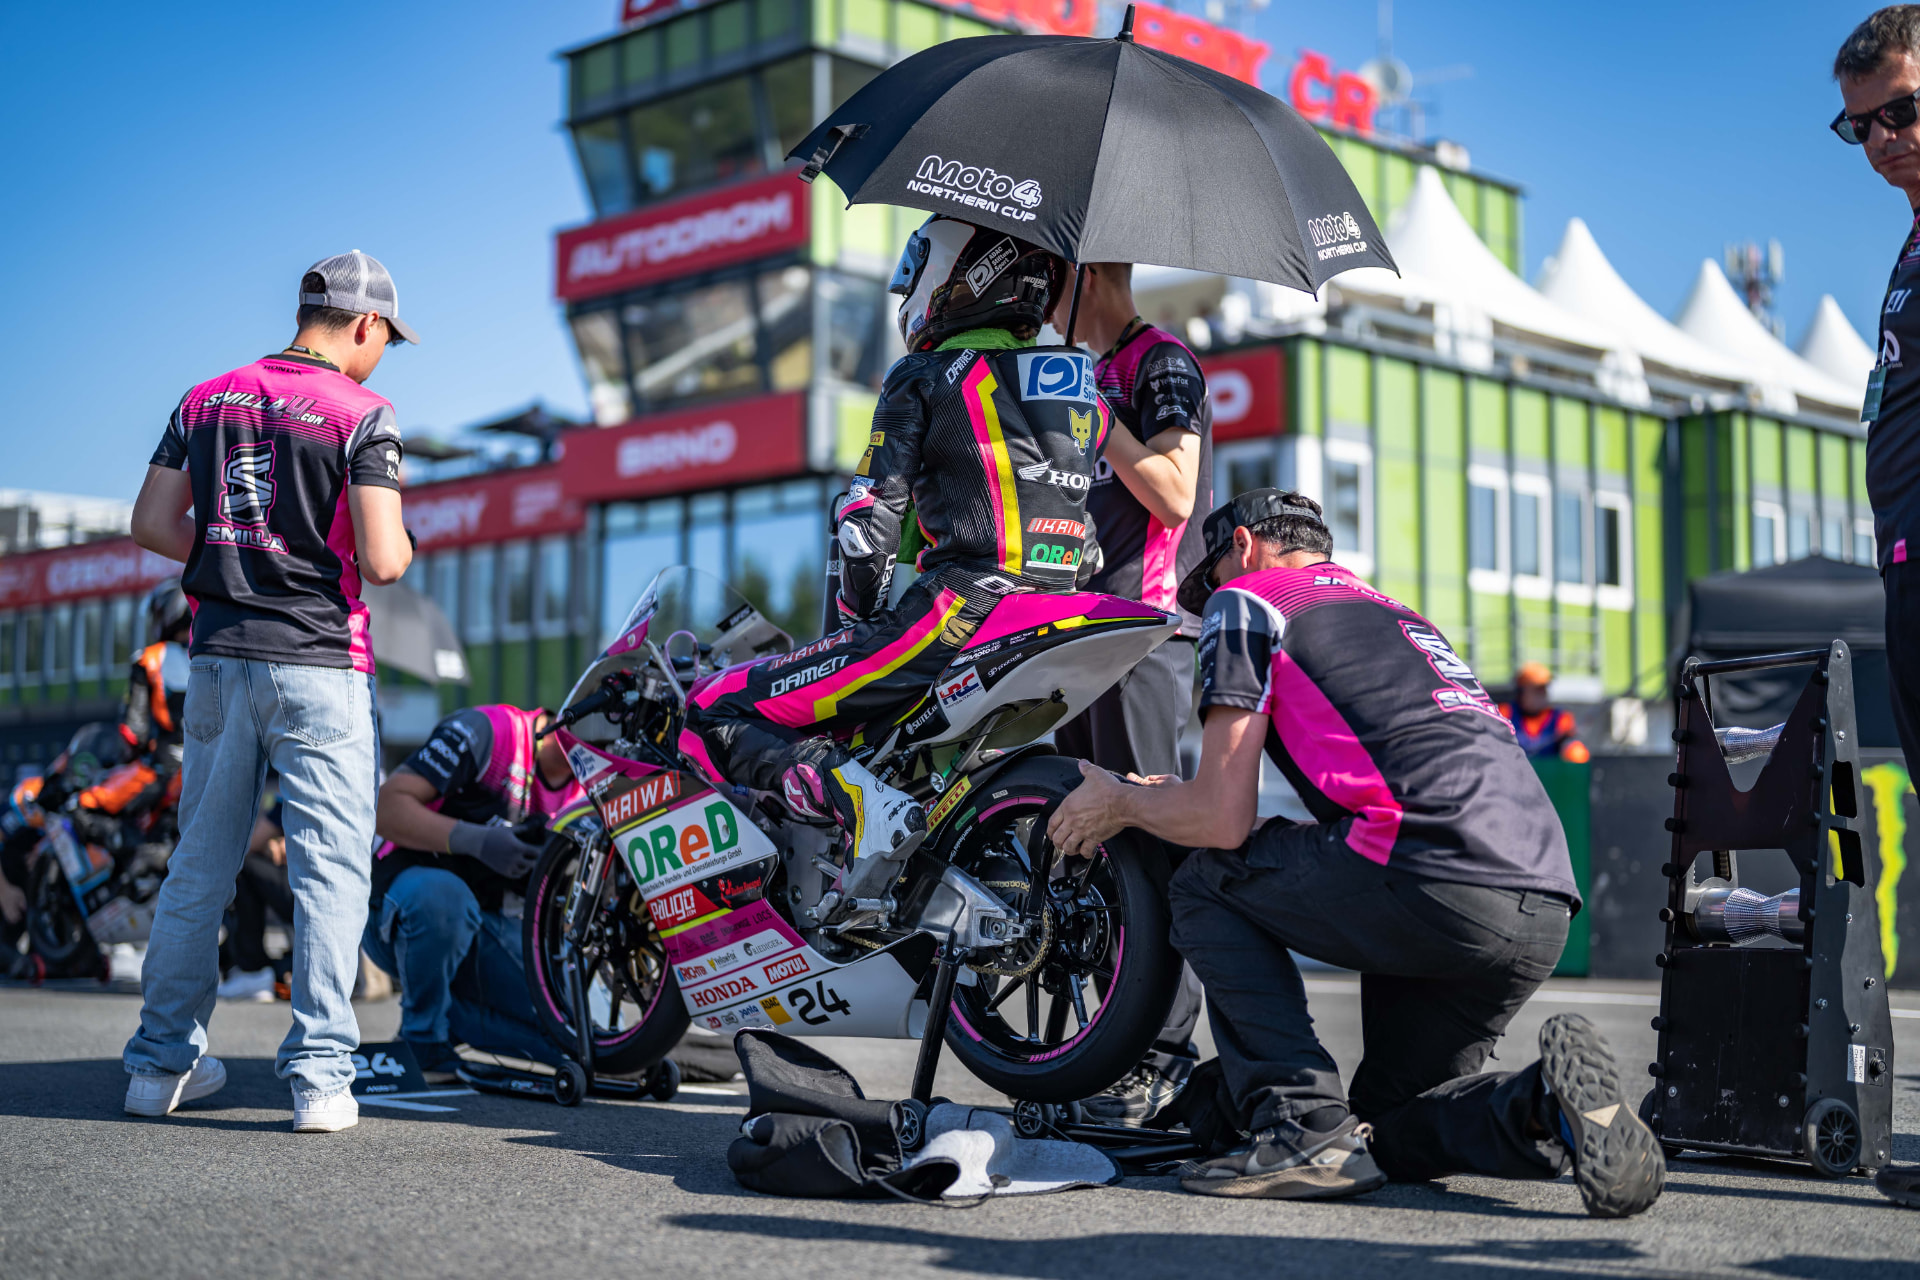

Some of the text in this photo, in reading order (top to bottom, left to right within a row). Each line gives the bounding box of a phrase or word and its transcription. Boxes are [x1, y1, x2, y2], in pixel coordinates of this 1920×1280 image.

[916, 155, 1042, 209] Moto4
[907, 180, 1036, 222] NORTHERN CUP
[568, 192, 792, 282] AUTODROM
[1308, 212, 1361, 247] Moto4
[988, 246, 1003, 260] ADAC
[995, 257, 1010, 271] Sport
[1318, 241, 1367, 260] NORTHERN CUP
[263, 365, 302, 376] HONDA
[616, 420, 738, 478] BRNO
[207, 527, 285, 551] SMILLA
[939, 672, 980, 705] HRC
[753, 909, 773, 925] LOCS
[768, 957, 807, 982] MOTUL
[690, 976, 758, 1008] HONDA
[788, 980, 851, 1025] 24
